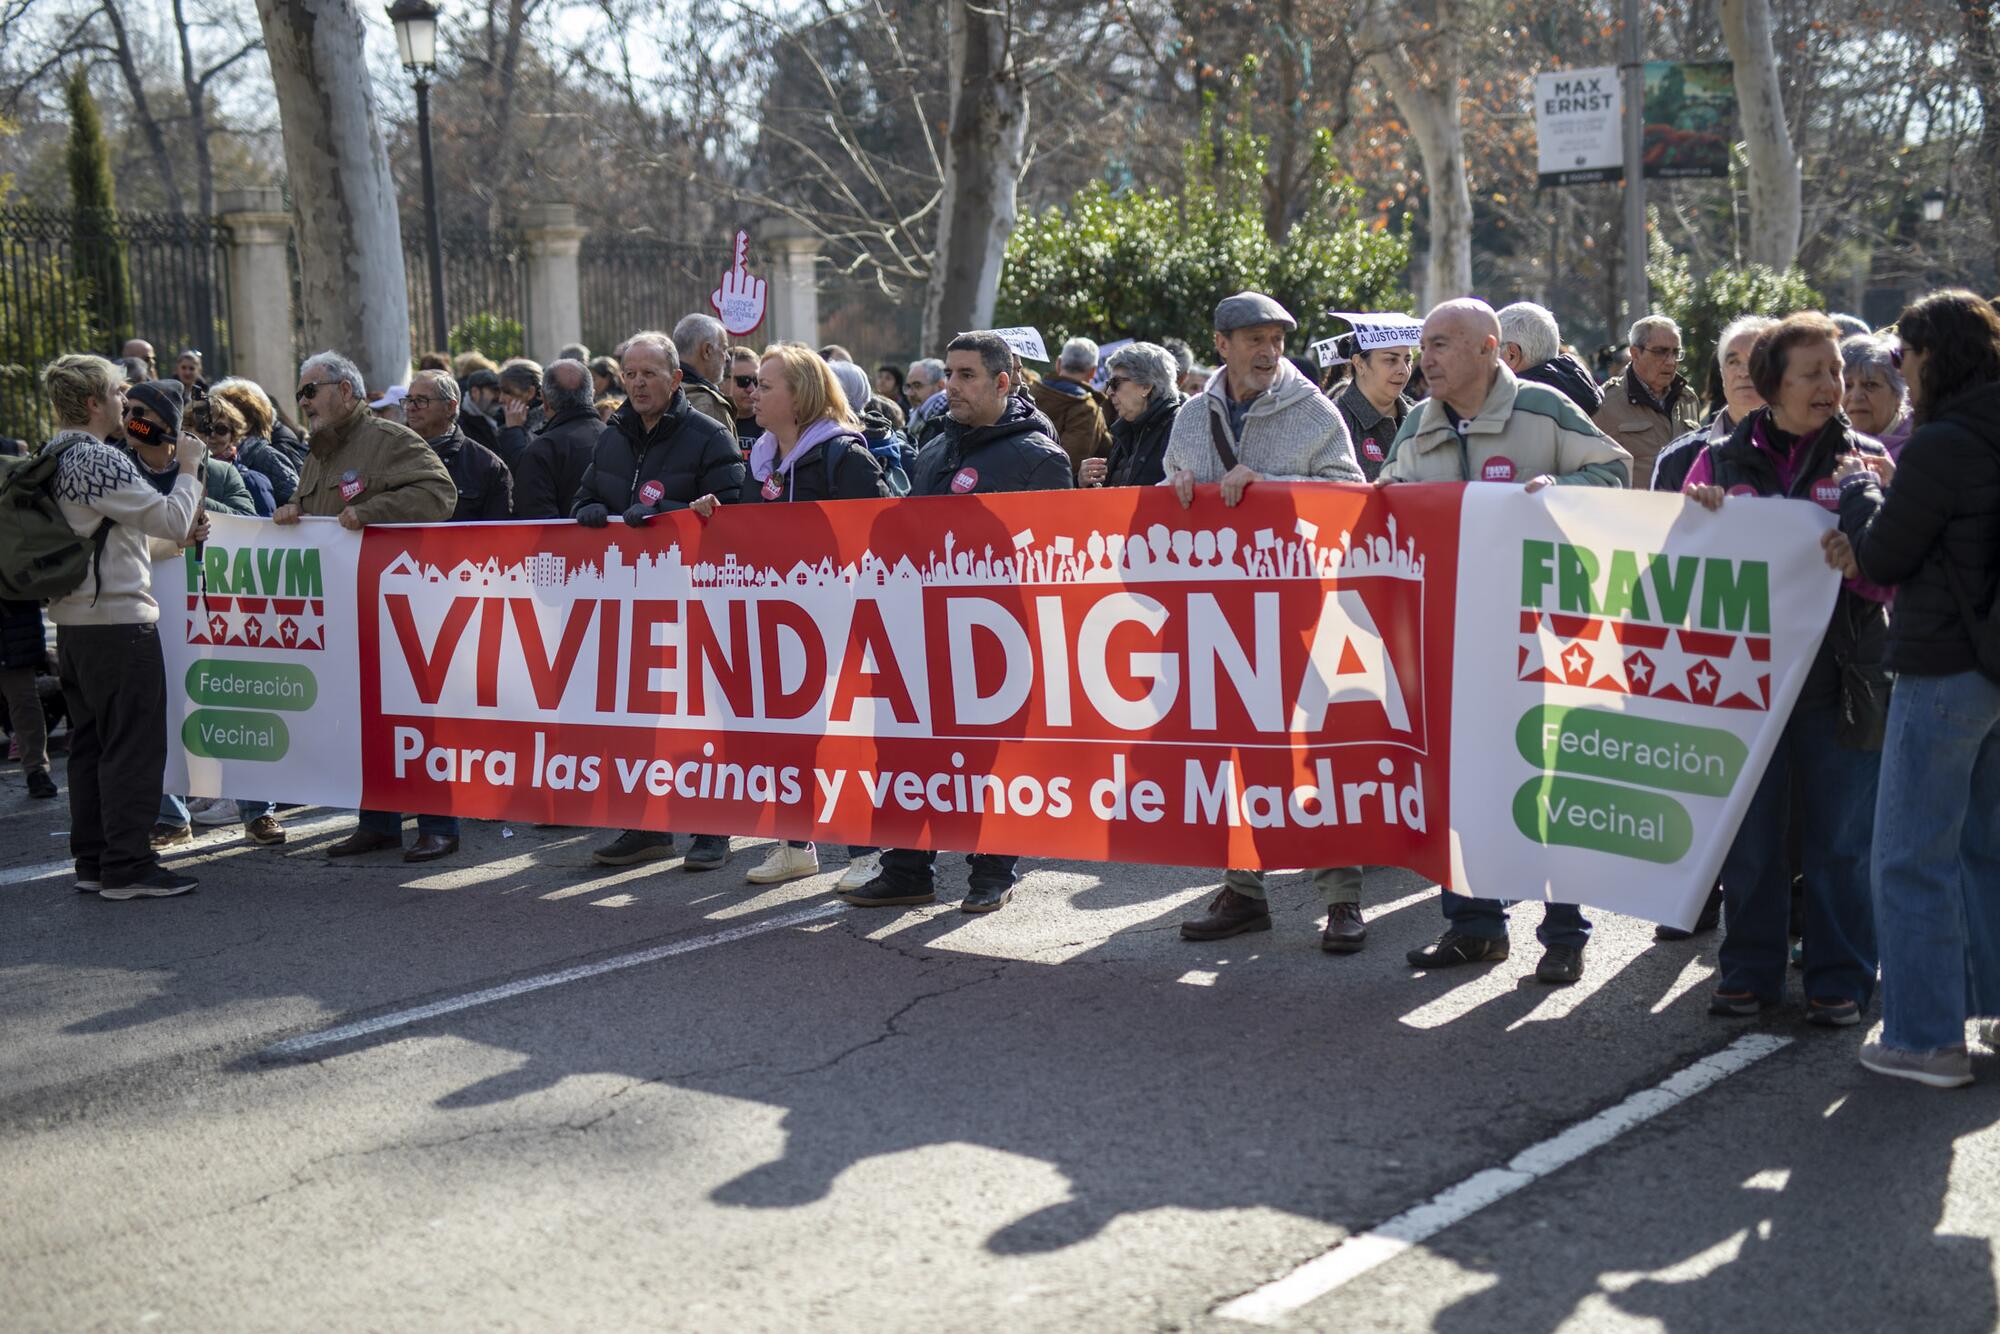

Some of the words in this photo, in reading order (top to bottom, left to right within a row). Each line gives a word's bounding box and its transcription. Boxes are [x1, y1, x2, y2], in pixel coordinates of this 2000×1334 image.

[1545, 94, 1613, 115] ERNST
[1556, 78, 1602, 95] MAX
[1361, 334, 1368, 343] A
[1369, 330, 1398, 343] JUSTO
[1398, 329, 1421, 340] PREC
[185, 546, 324, 597] FRAVM
[1520, 538, 1771, 634] FRAVM
[200, 673, 304, 697] Federación
[384, 593, 920, 724] VIVIENDA
[945, 590, 1412, 733] DIGNA
[201, 723, 274, 747] Vecinal
[1542, 723, 1725, 777] Federación
[394, 726, 516, 786] Para
[532, 732, 601, 793] las
[614, 742, 802, 804] vecinas
[813, 769, 847, 824] y
[858, 751, 1072, 819] vecinos
[1090, 753, 1165, 824] de
[1184, 758, 1427, 834] Madrid
[1543, 795, 1664, 843] Vecinal
